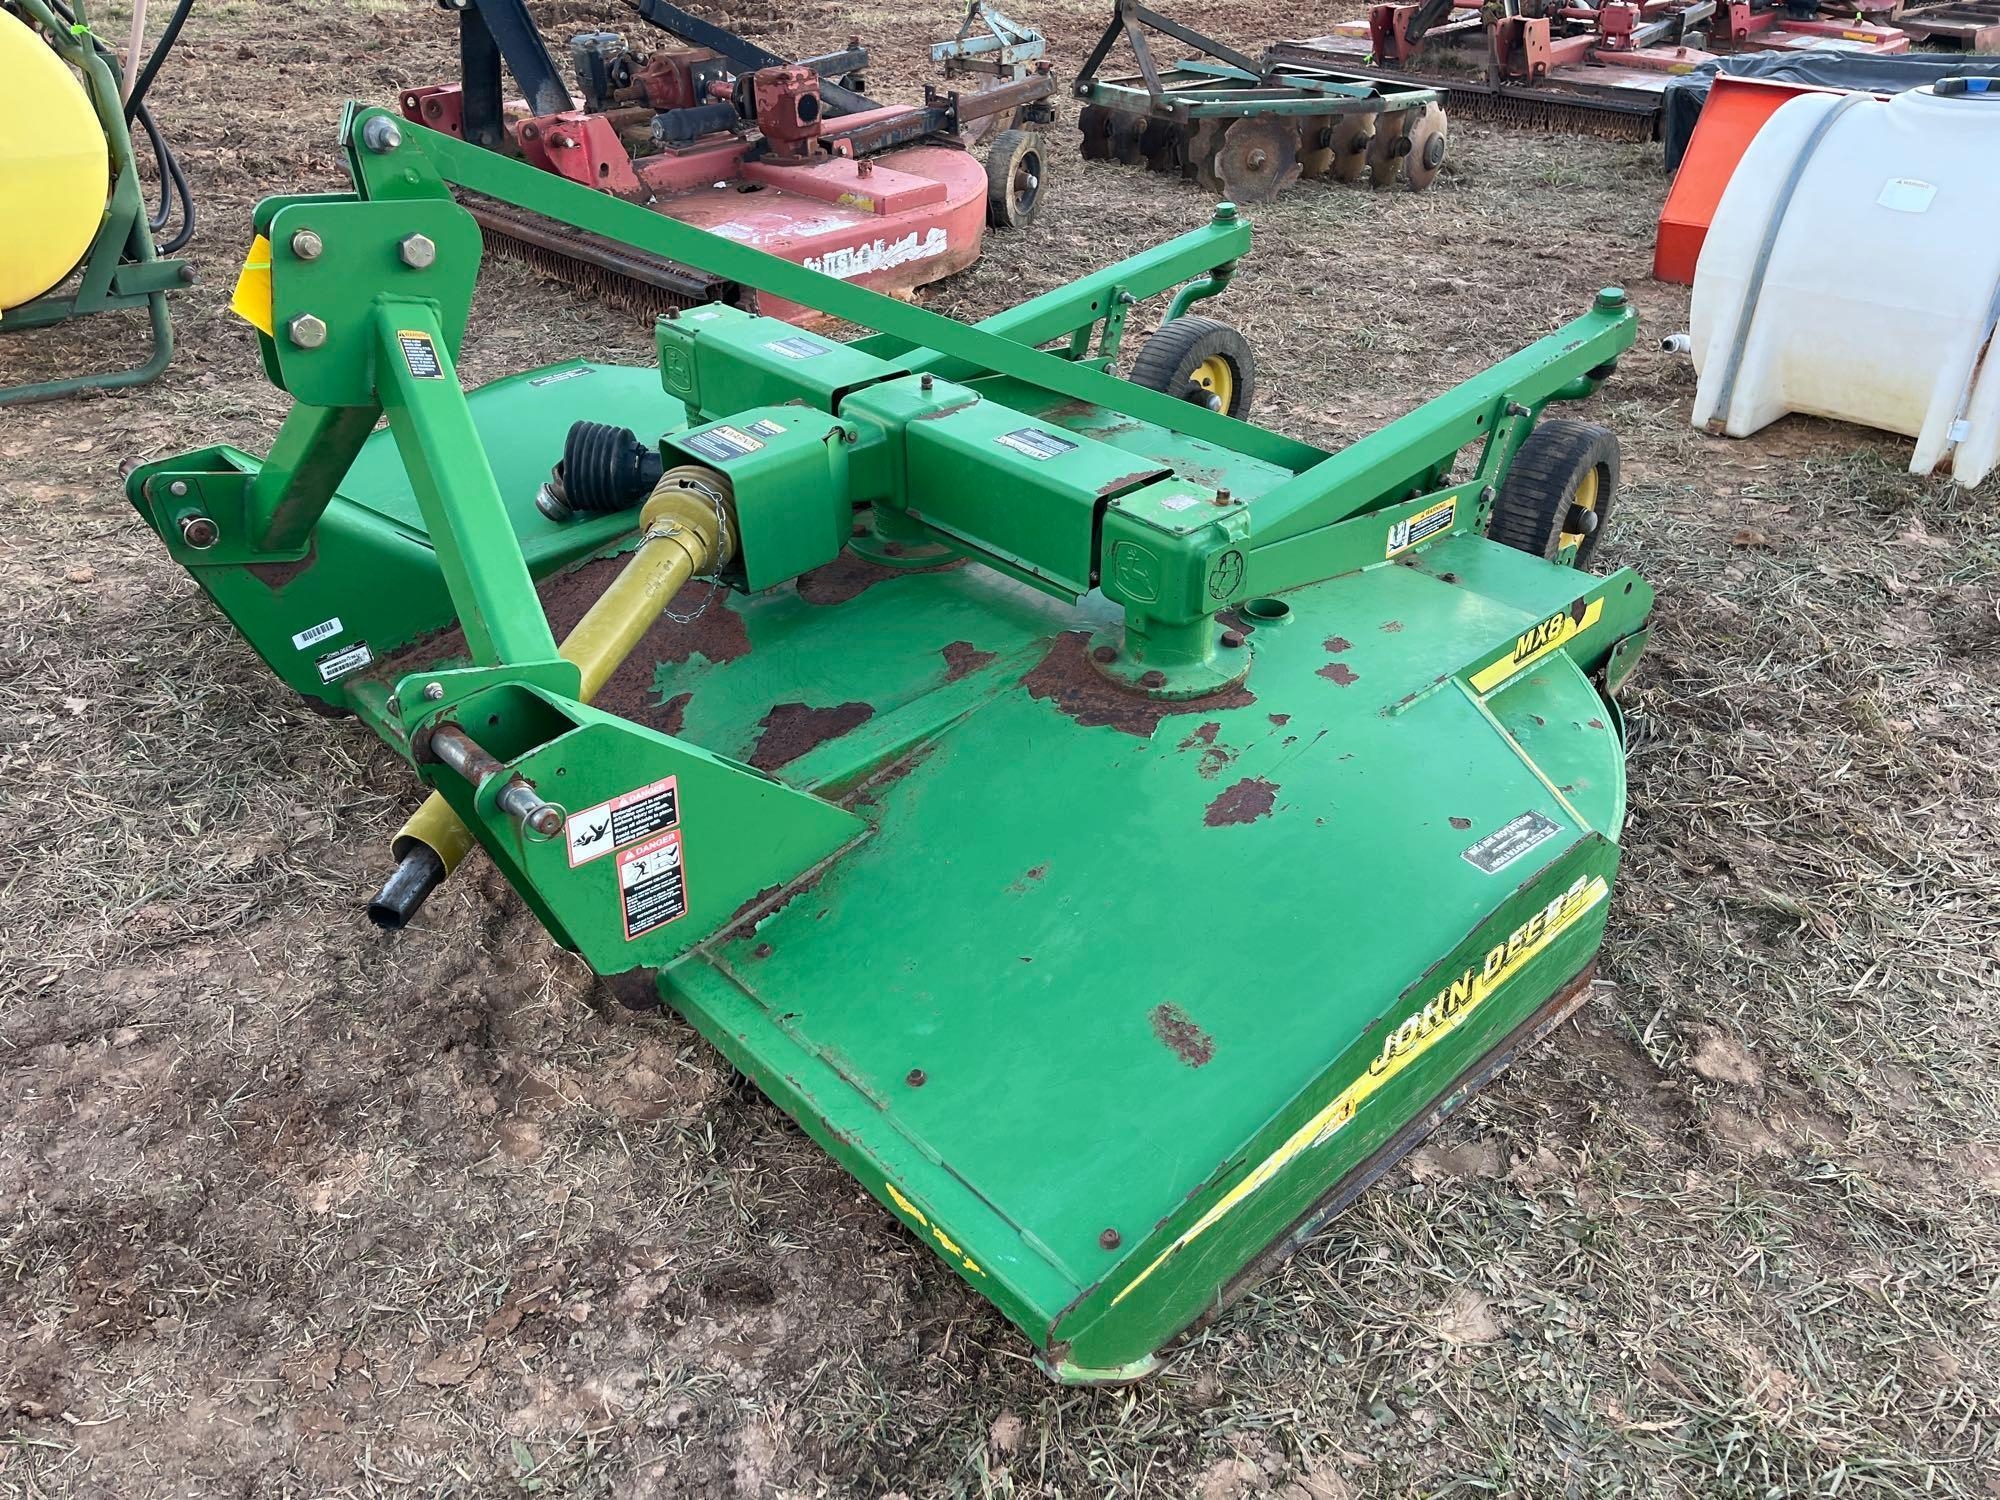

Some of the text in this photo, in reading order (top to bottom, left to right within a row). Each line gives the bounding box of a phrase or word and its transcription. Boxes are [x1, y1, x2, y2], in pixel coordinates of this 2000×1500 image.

[1513, 611, 1565, 664] MX8
[629, 783, 666, 802] DANGER
[1494, 814, 1533, 838] ROTATION
[635, 833, 675, 854] DANGER
[1369, 966, 1476, 1076] JOHN
